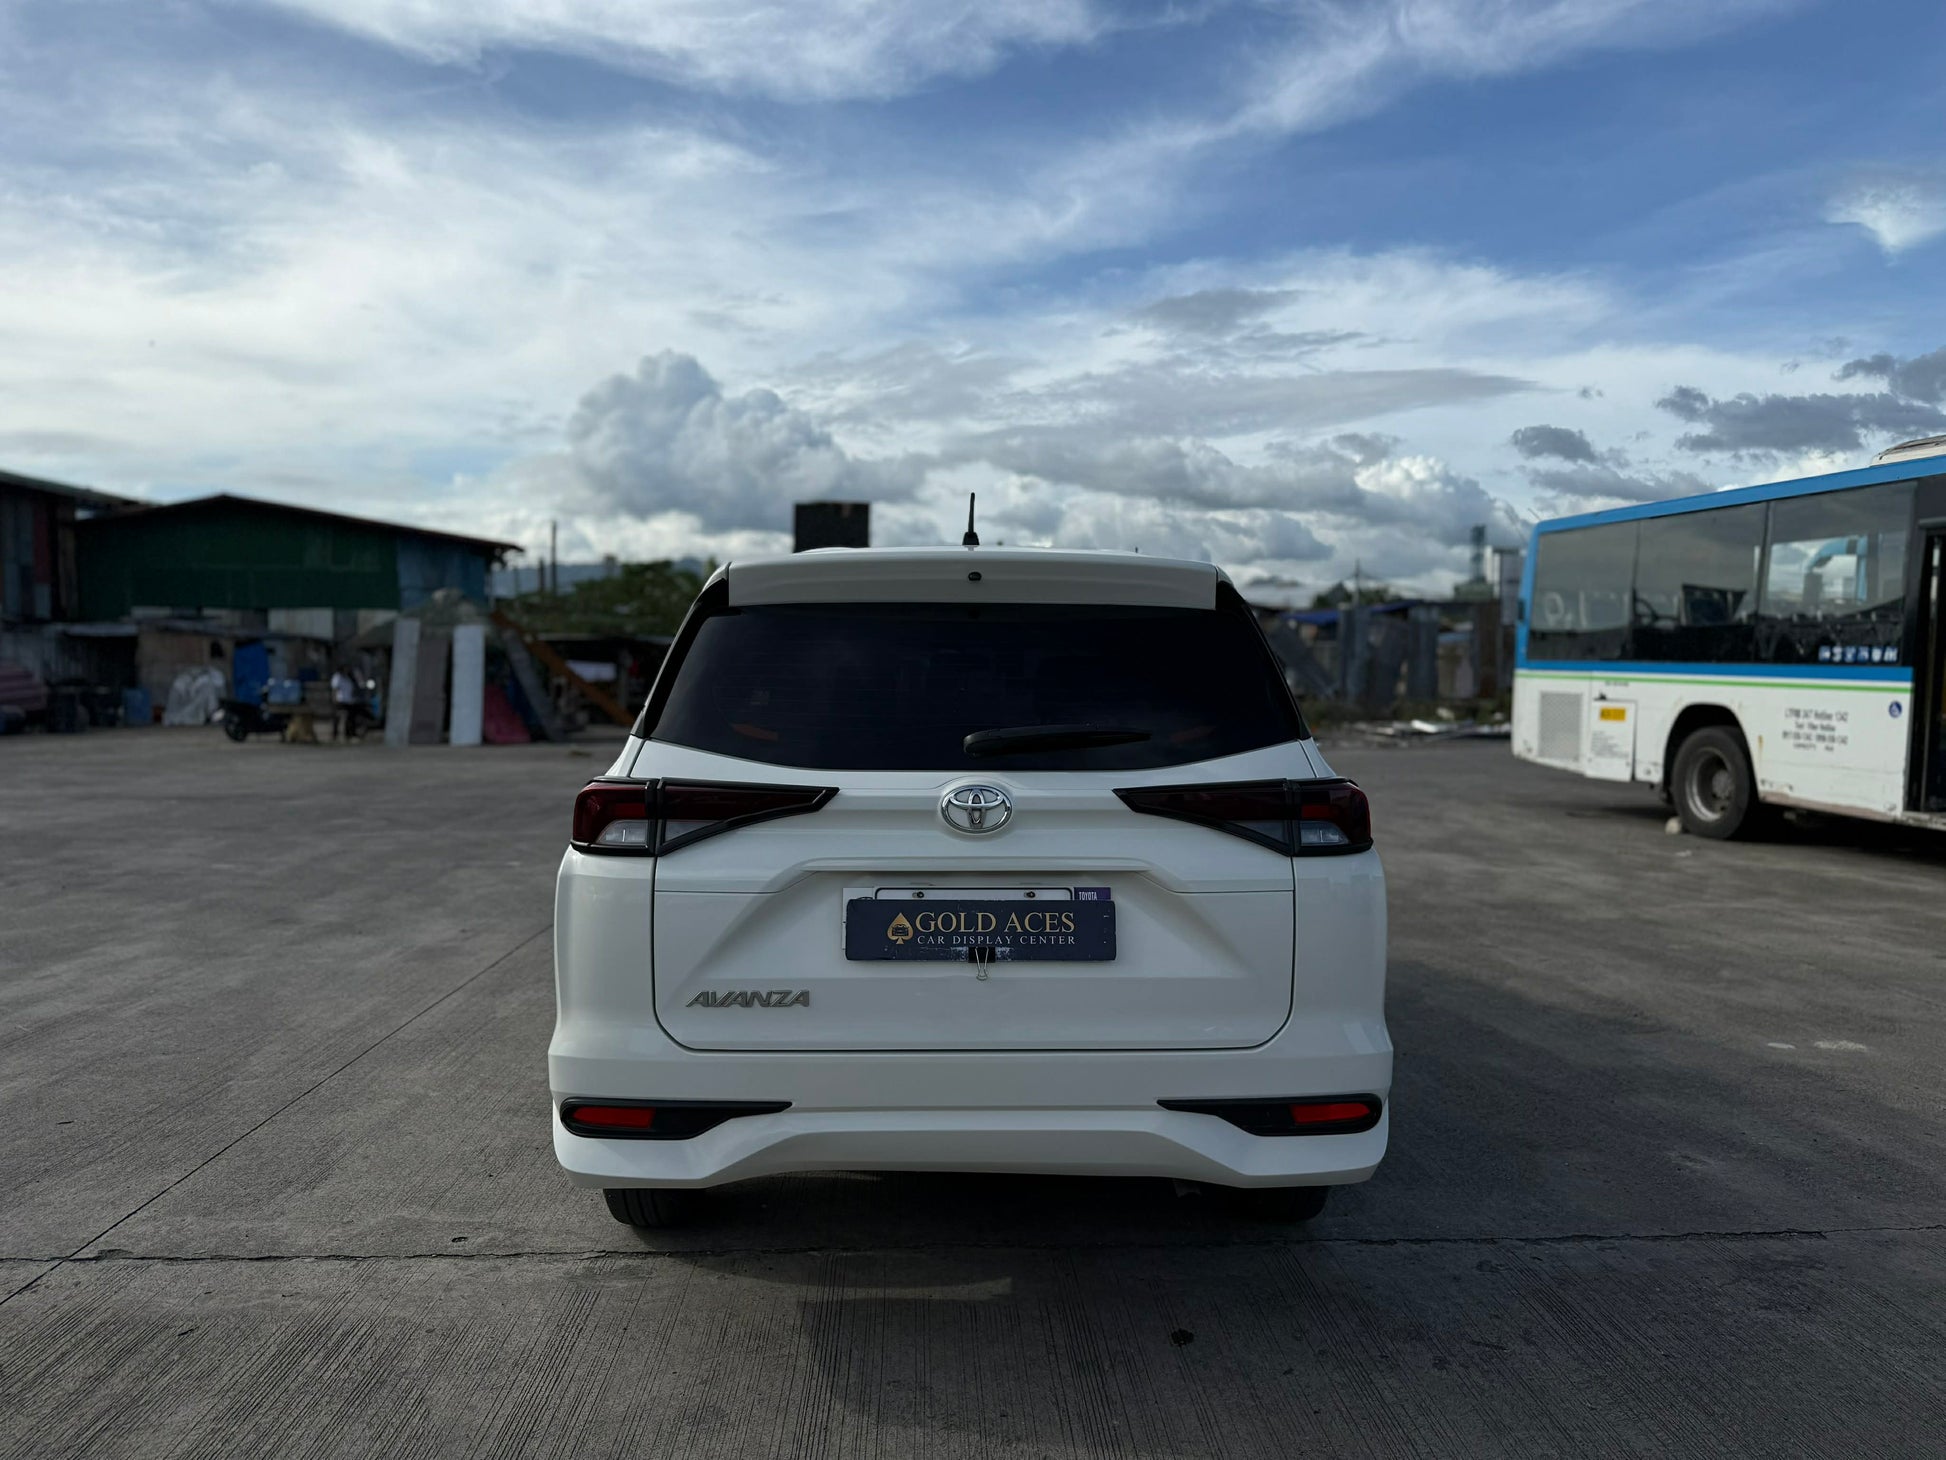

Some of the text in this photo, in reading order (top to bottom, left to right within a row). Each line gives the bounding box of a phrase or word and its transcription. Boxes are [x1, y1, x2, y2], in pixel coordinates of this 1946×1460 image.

[1079, 891, 1098, 901] TOYOTA
[915, 911, 1076, 933] GOLD ACES
[917, 935, 1076, 945] CAR DISPLAY CENTER
[685, 989, 810, 1008] AVANZA
